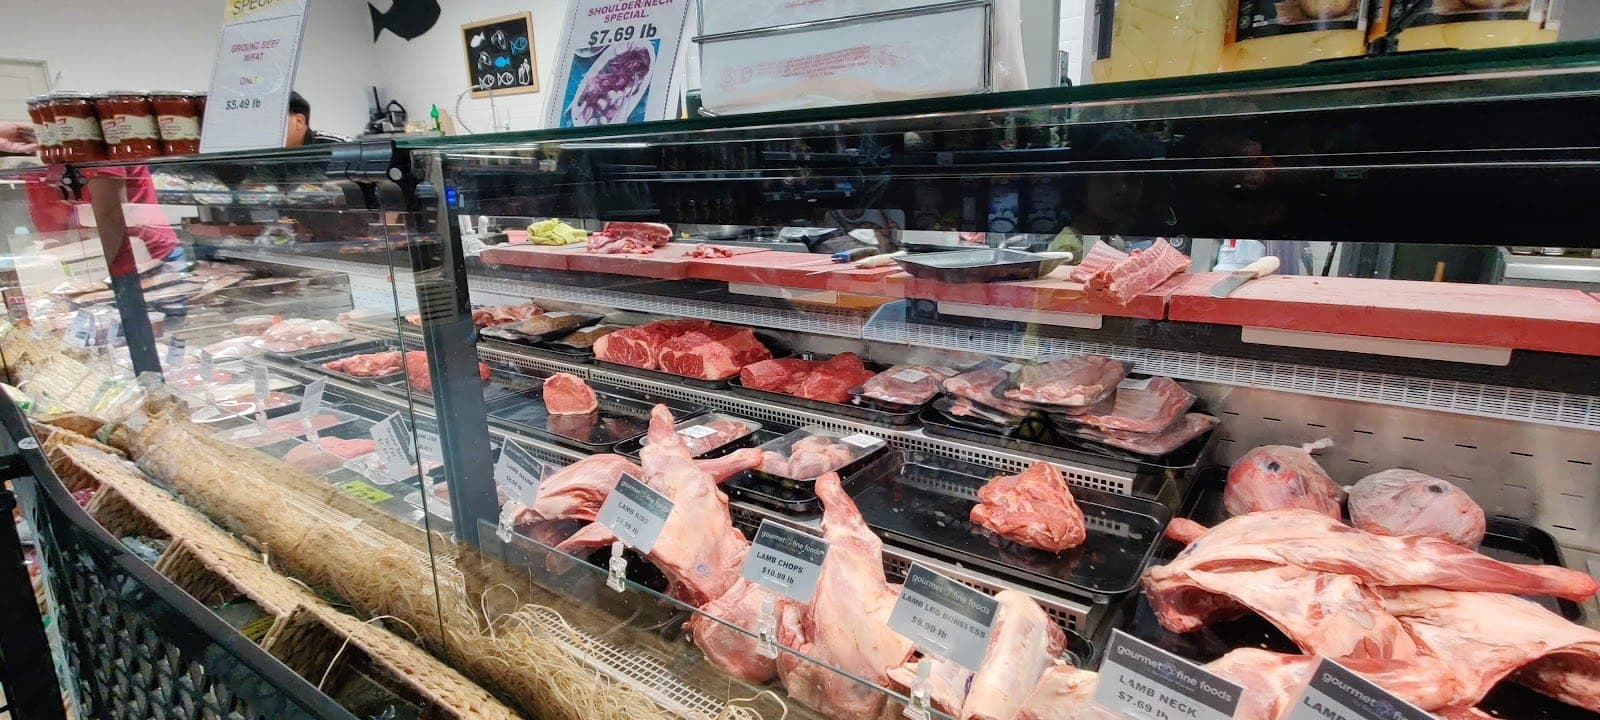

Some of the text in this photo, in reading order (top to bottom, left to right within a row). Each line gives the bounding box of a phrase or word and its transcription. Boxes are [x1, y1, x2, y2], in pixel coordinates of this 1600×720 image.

[604, 10, 649, 23] SPECIAL.
[588, 23, 657, 46] $7.69 lb
[225, 98, 250, 110] $5.49
[618, 502, 635, 515] LAMB
[761, 531, 786, 544] gourmet
[756, 551, 804, 574] LAMB CHOPS
[761, 566, 794, 584] $10.99 lb
[912, 574, 943, 593] gourmet
[968, 598, 991, 615] foods
[902, 592, 986, 639] LAMB LEG BONELESS
[911, 615, 947, 639] $9.99 lb
[1116, 644, 1162, 671] gourmet
[1176, 671, 1198, 687] fine
[1199, 680, 1232, 703] foods
[1118, 690, 1153, 713] $7.69
[1119, 674, 1156, 698] LAMB
[1159, 693, 1198, 719] NECK
[1321, 672, 1377, 708] gourmet
